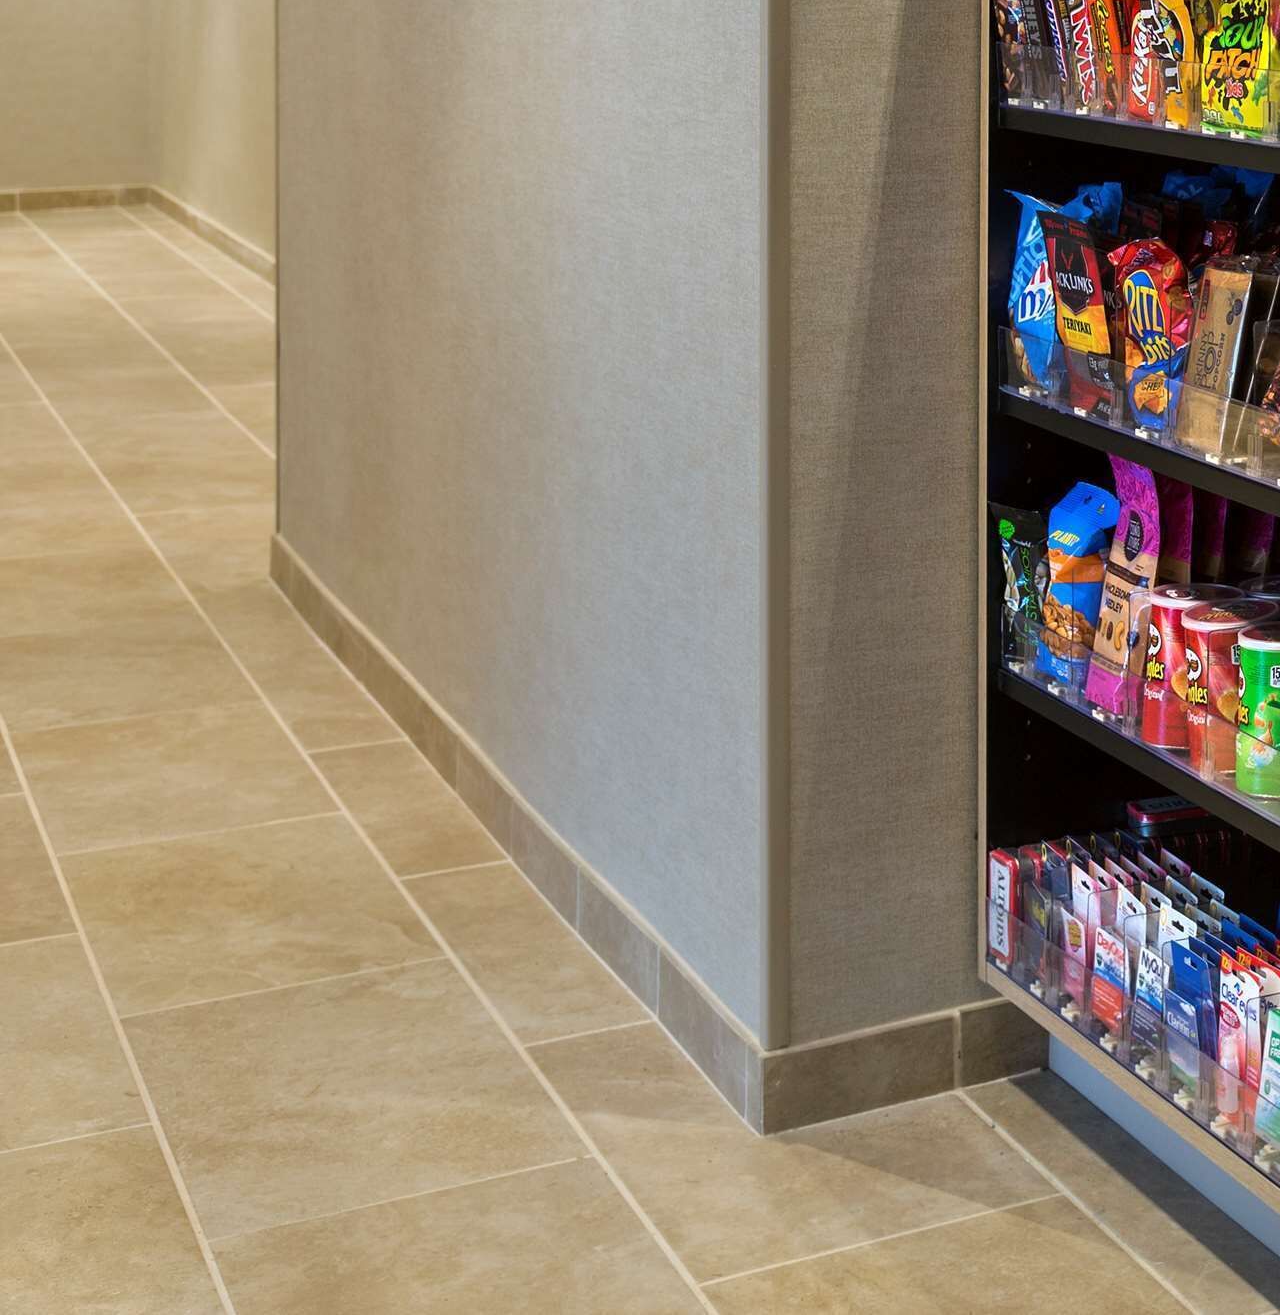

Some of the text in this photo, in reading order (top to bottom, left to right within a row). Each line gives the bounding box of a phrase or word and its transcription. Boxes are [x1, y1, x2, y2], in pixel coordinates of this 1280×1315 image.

[1205, 48, 1260, 80] PATCH
[1062, 316, 1092, 336] TERIYAKI
[1124, 279, 1166, 336] RITZ
[996, 868, 1006, 947] ALTOIDS
